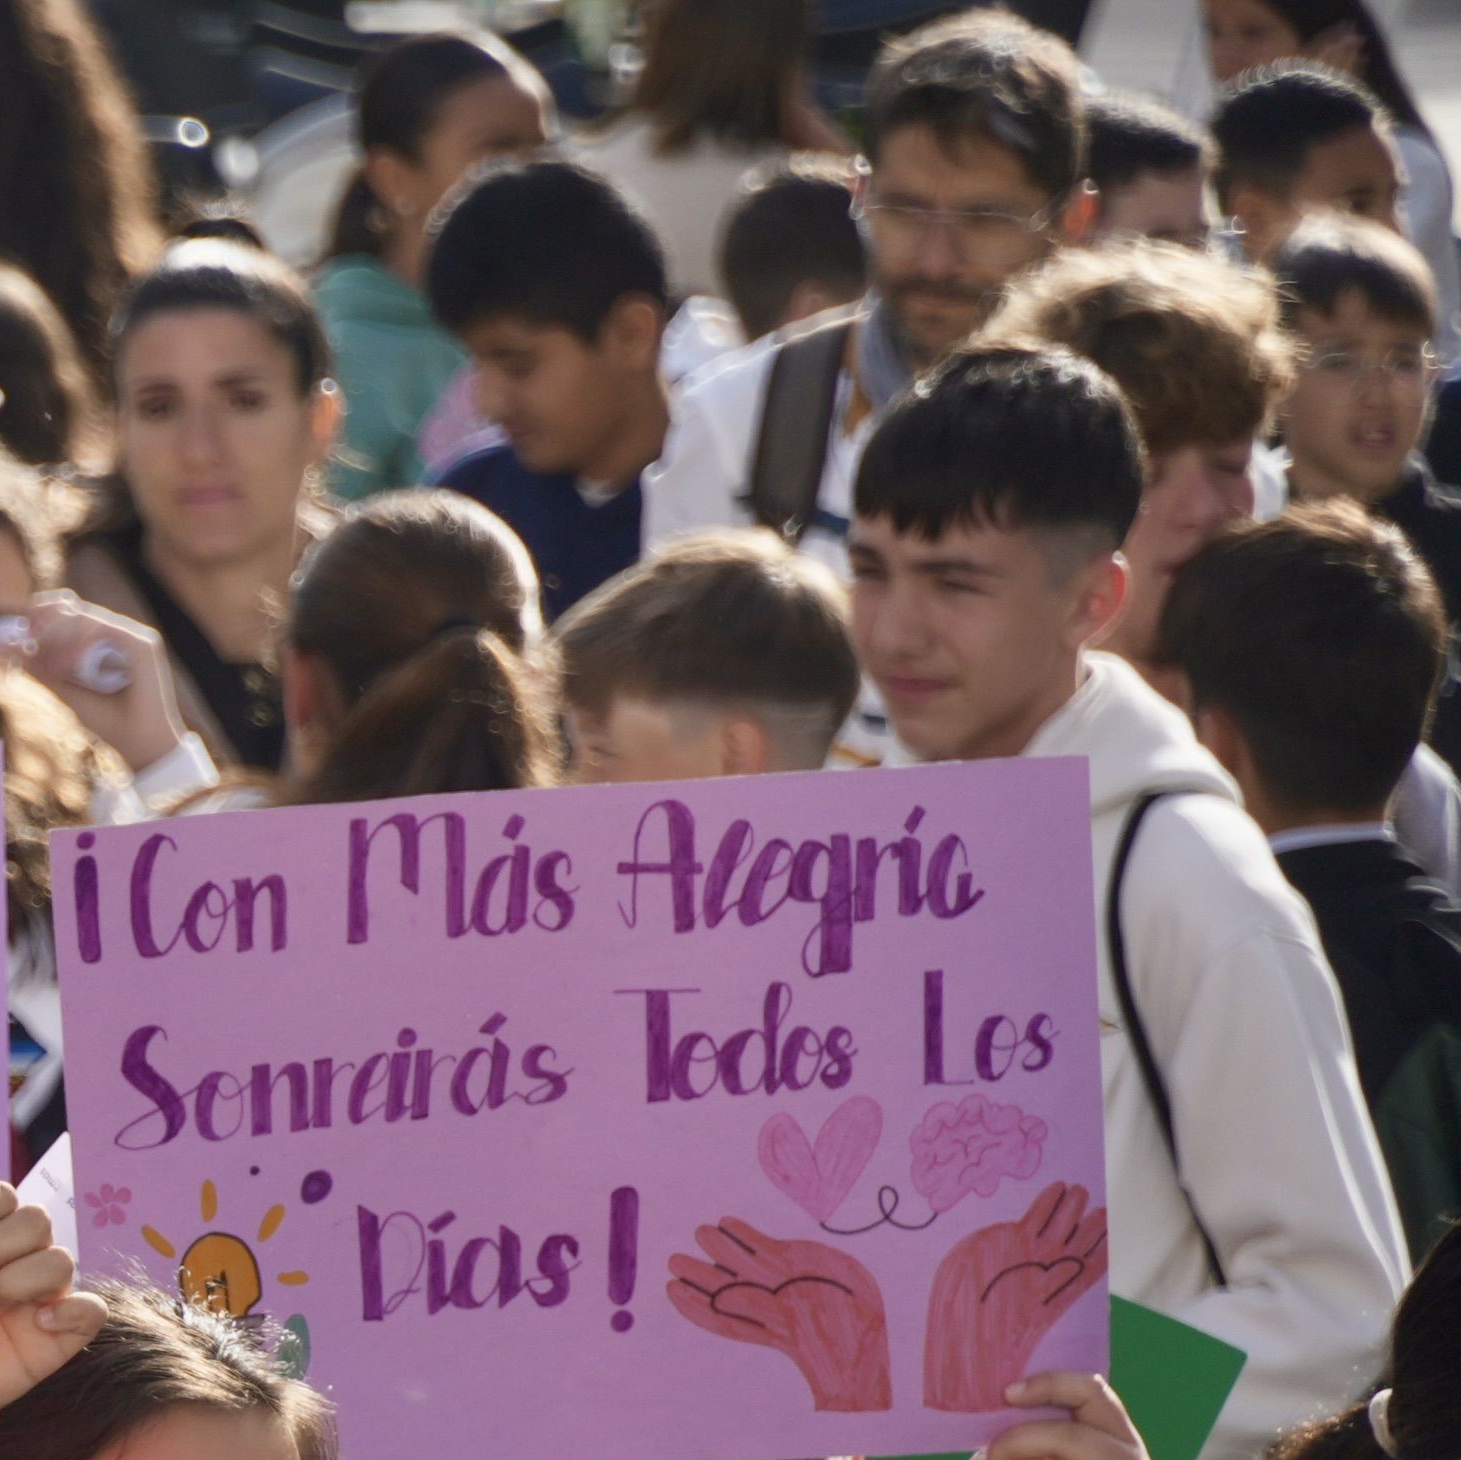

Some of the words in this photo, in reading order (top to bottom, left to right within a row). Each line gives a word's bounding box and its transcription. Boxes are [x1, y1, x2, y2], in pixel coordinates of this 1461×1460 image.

[73, 830, 287, 964] ¡Con
[346, 811, 581, 945] Más
[616, 798, 986, 978] Alegría
[613, 981, 859, 1103] Todos
[922, 969, 1061, 1086] Los
